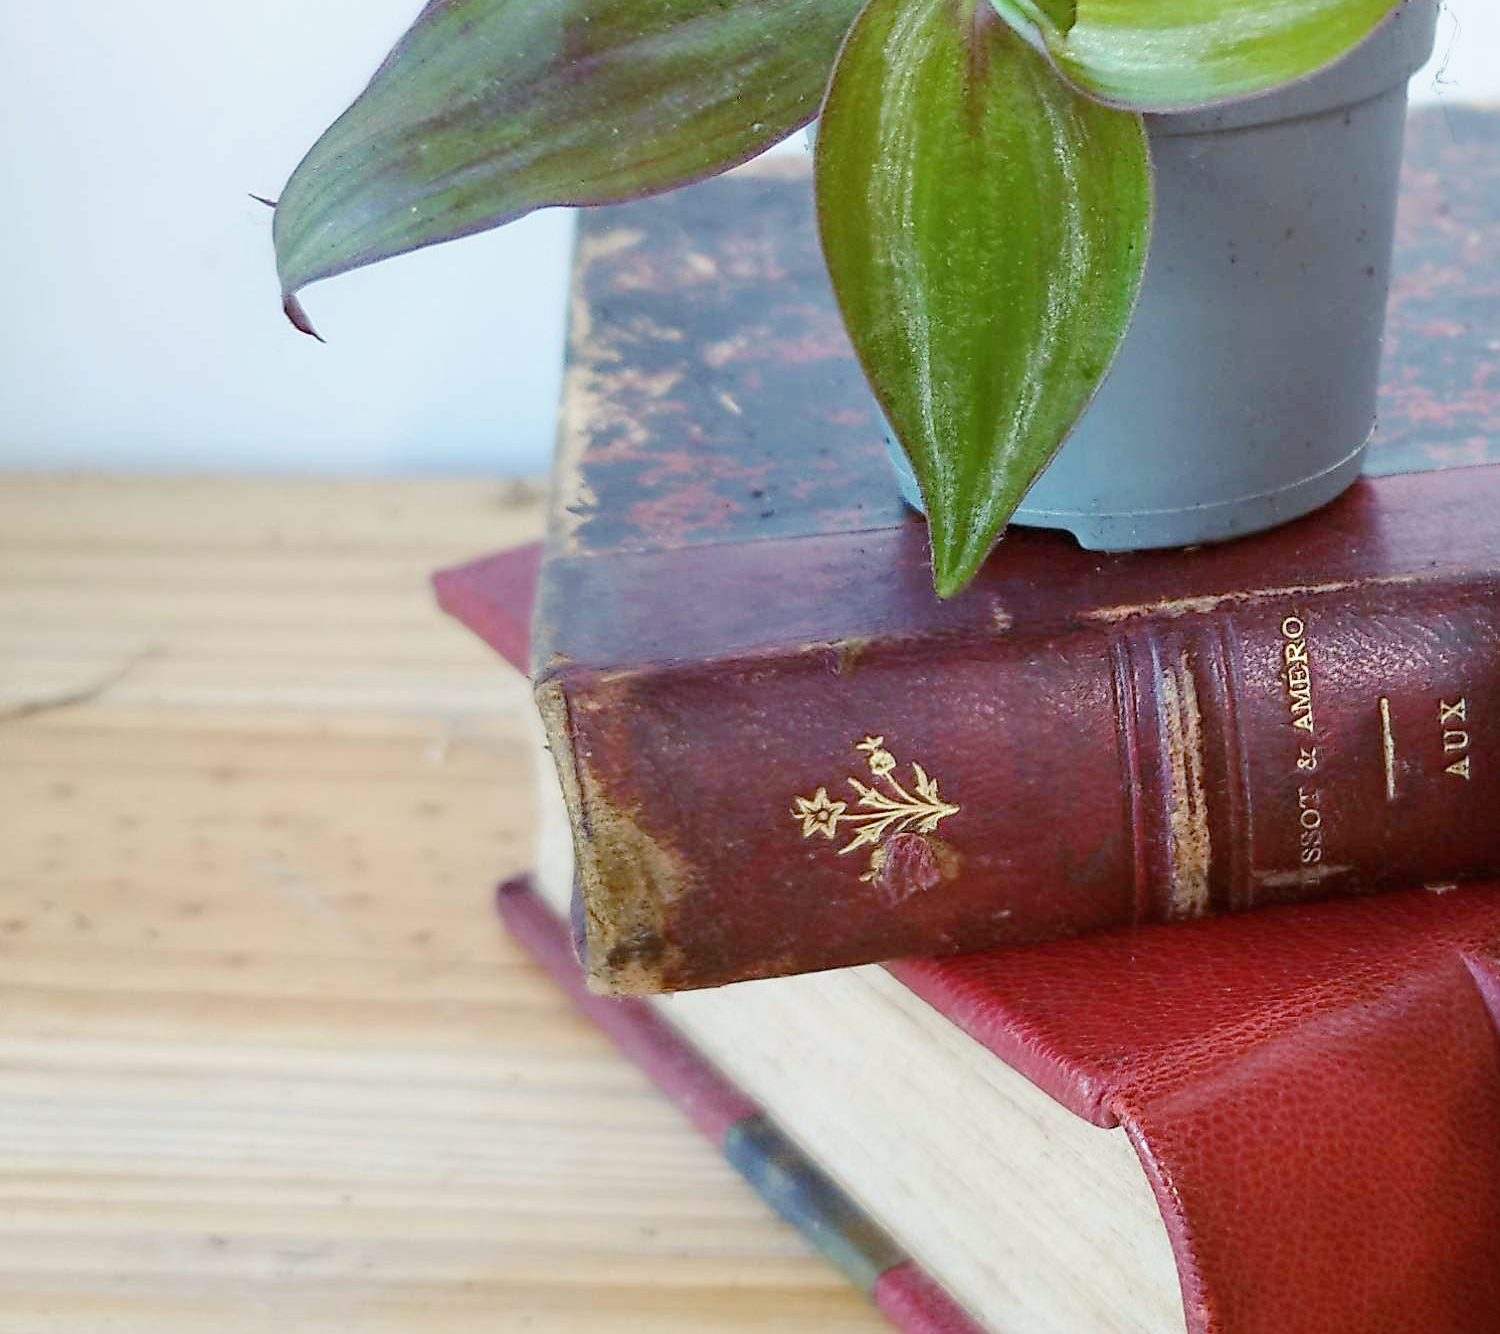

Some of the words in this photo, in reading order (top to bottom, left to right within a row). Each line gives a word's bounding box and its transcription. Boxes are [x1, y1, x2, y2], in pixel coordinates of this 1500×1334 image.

[1281, 616, 1313, 732] AMÉRO
[1297, 746, 1317, 771] &
[1440, 697, 1471, 780] AUX
[1299, 786, 1322, 884] SSOT
